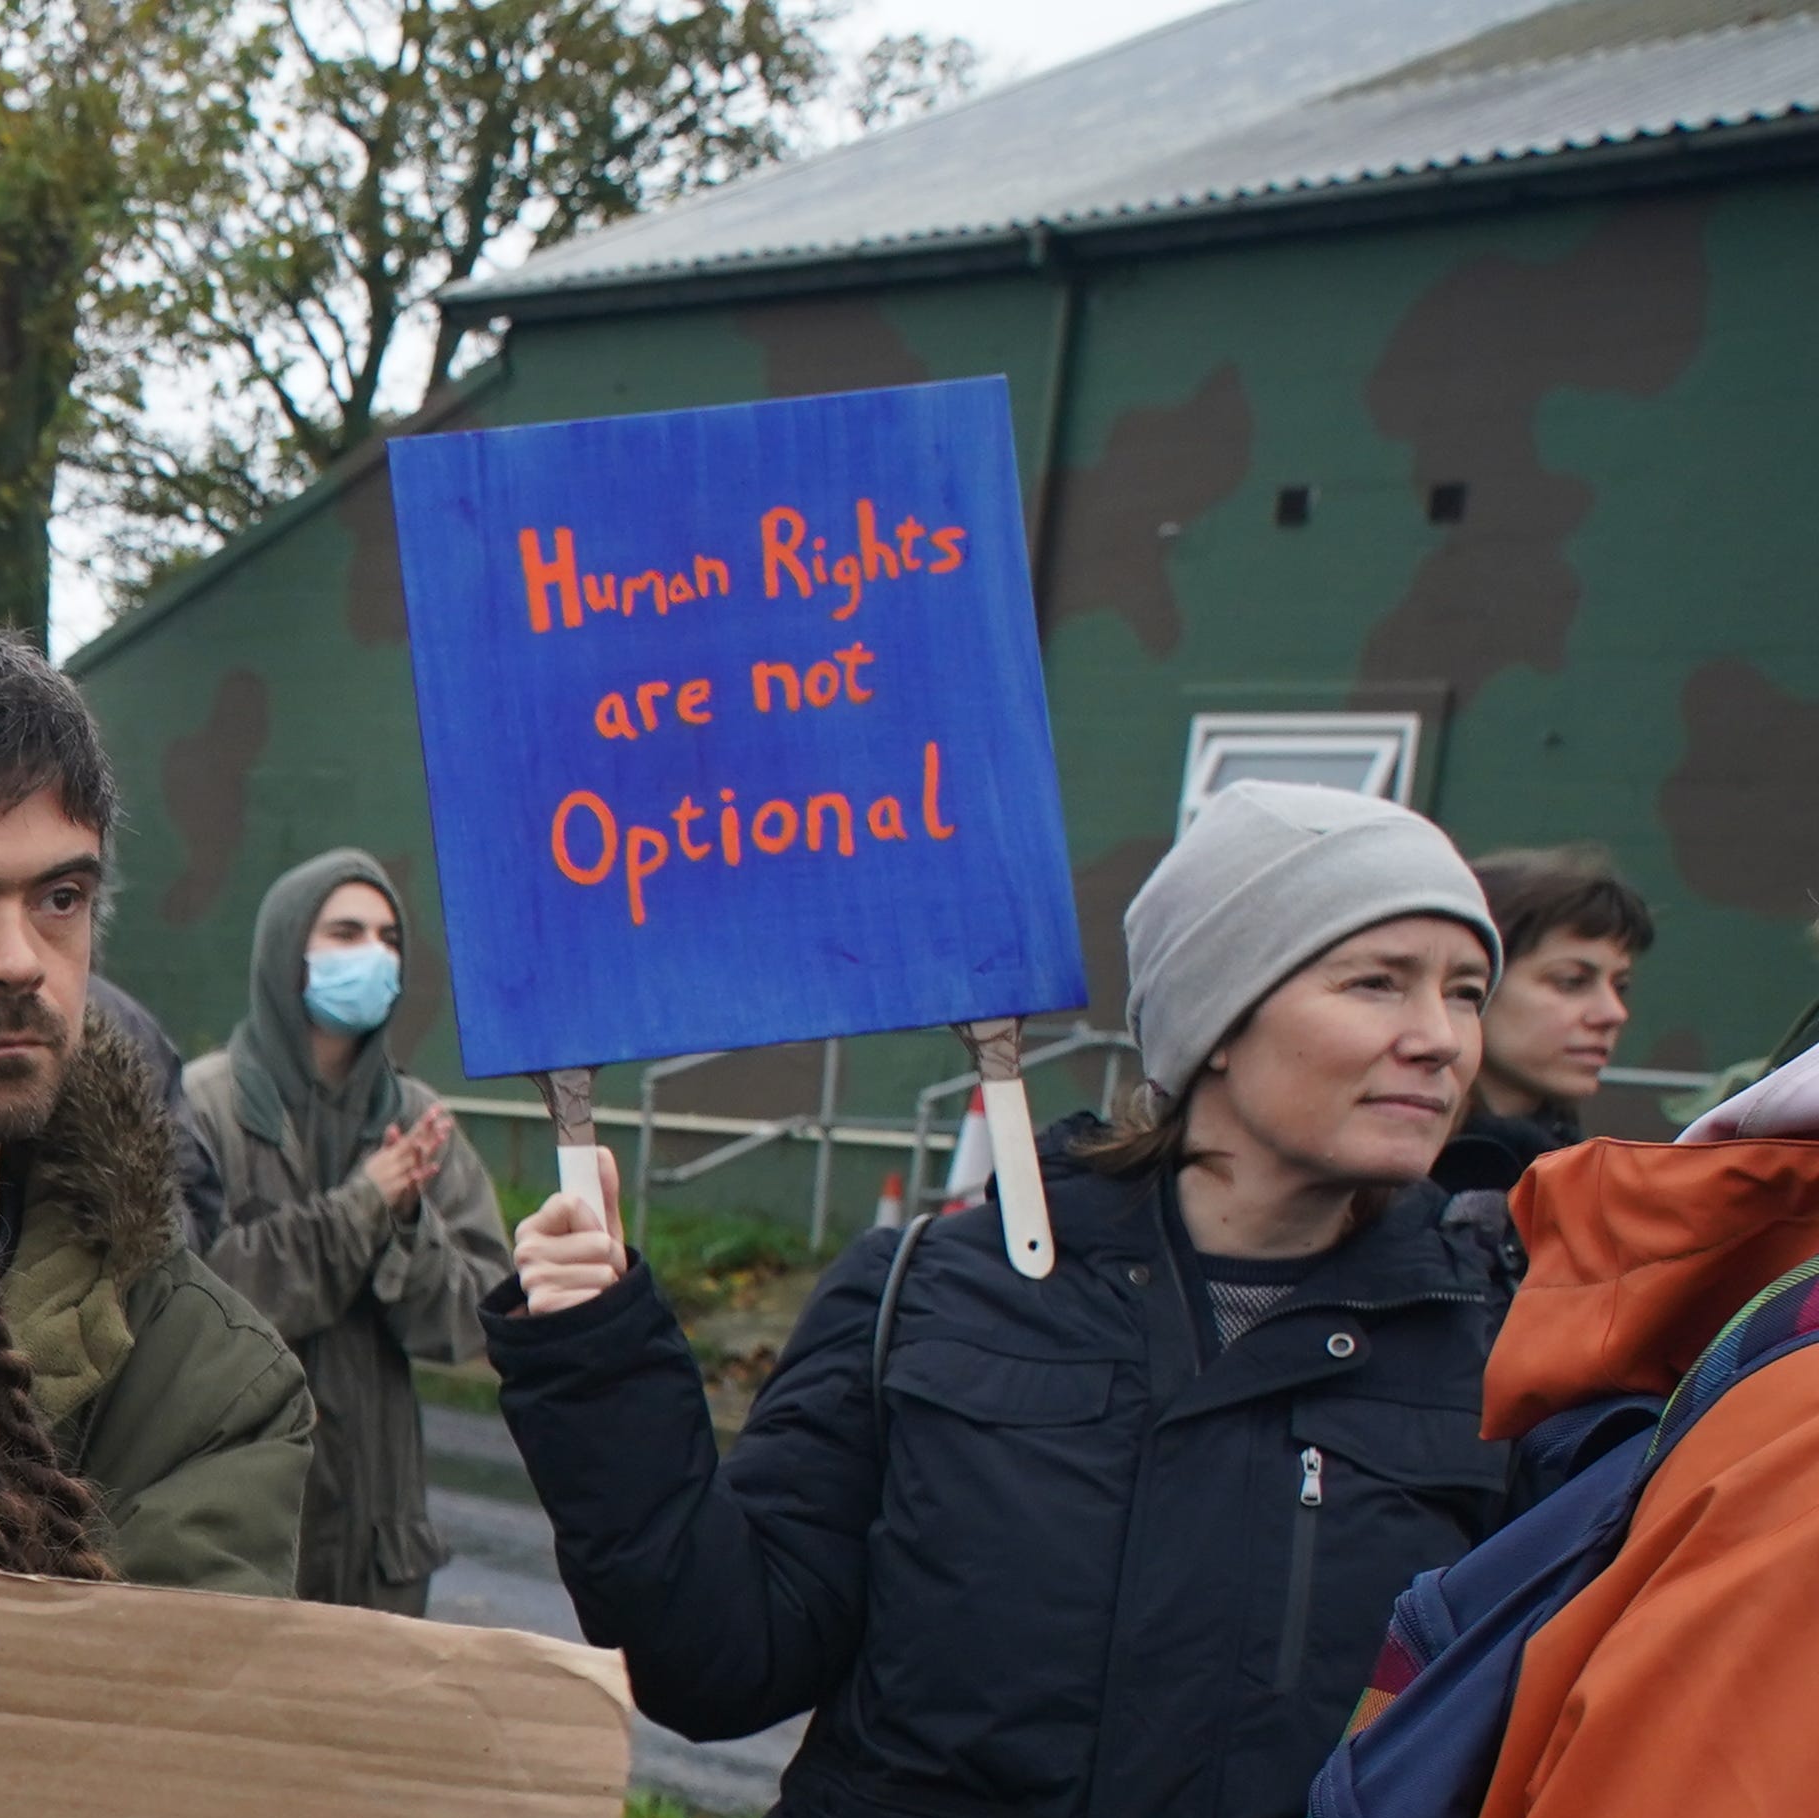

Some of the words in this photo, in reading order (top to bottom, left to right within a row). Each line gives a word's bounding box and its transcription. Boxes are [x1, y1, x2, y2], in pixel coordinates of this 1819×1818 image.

[519, 526, 730, 632] Human
[761, 497, 967, 620] Rights
[594, 677, 712, 741] are
[751, 642, 875, 713] not
[550, 741, 955, 926] Optional
